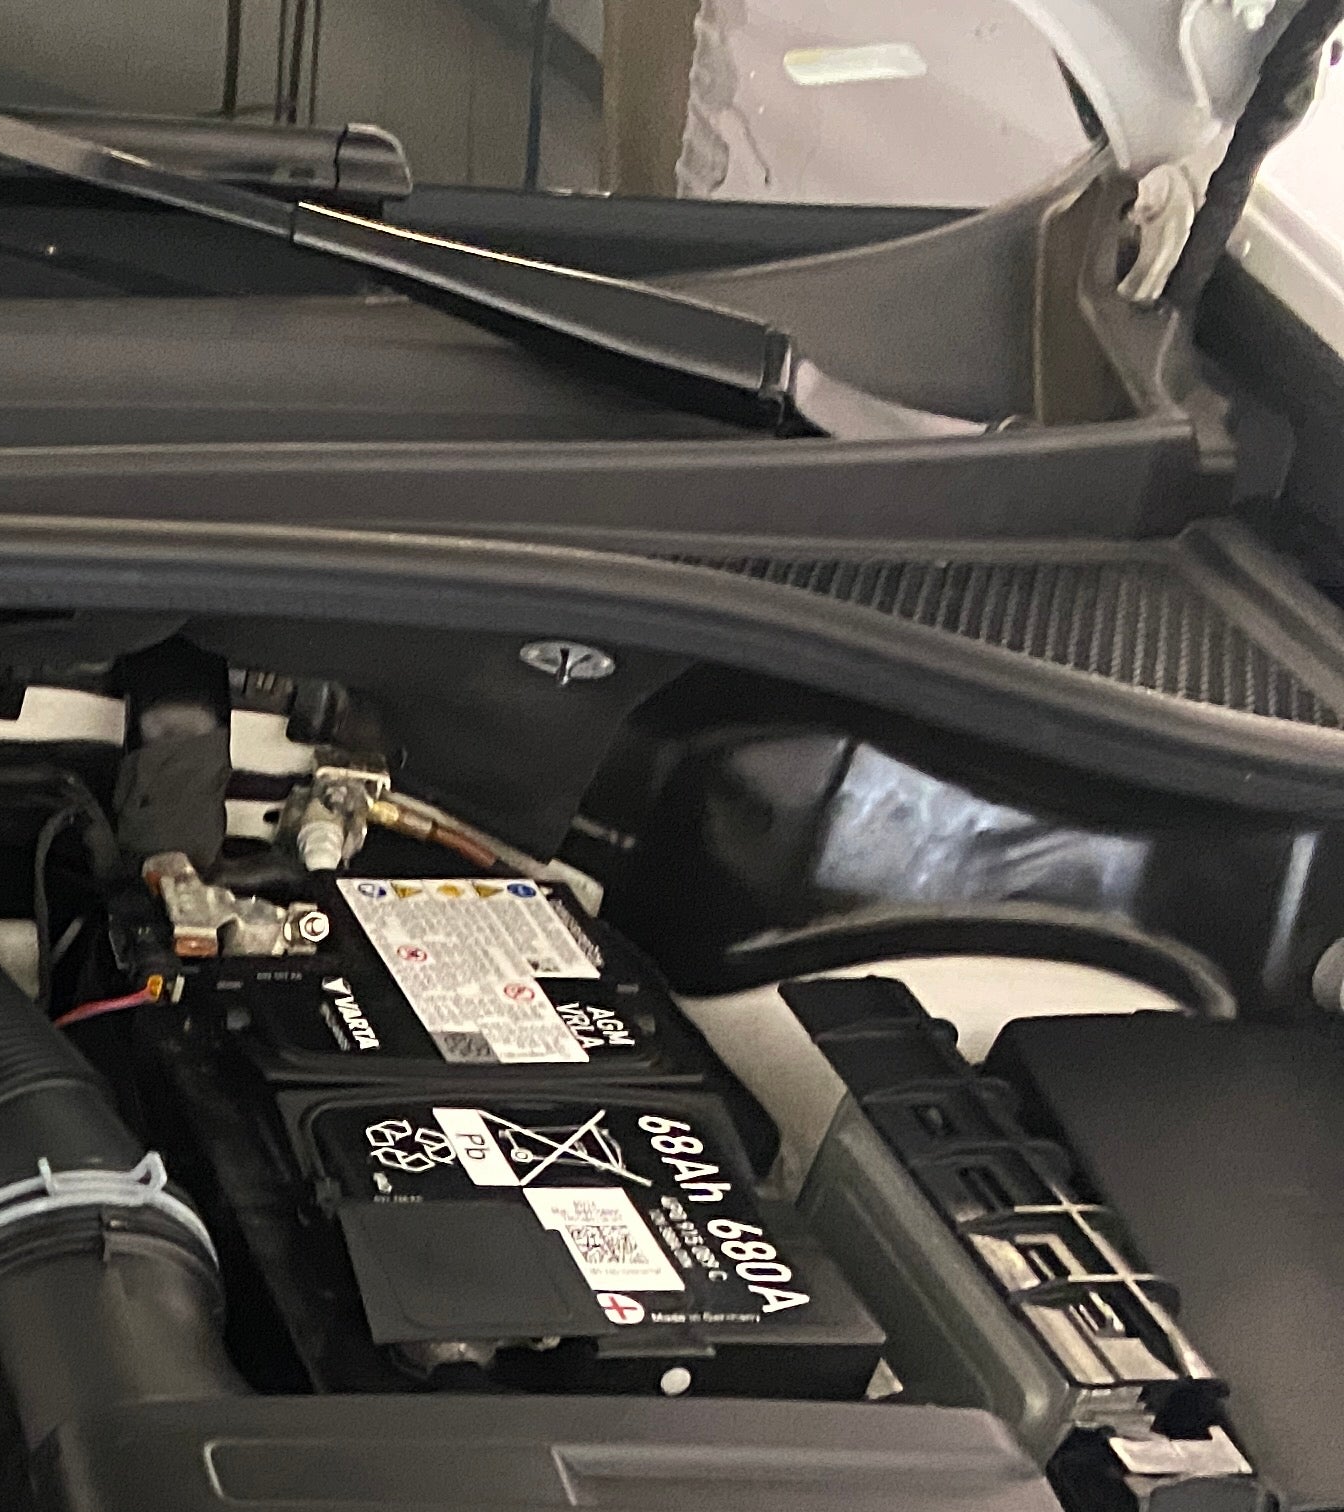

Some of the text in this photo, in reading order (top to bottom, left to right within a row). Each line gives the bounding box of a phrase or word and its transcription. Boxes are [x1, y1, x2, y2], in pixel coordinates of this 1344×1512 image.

[334, 994, 380, 1050] VARTA
[556, 1001, 606, 1049] VRLA
[586, 1005, 636, 1047] AGM
[455, 1132, 490, 1160] Pb
[637, 1114, 732, 1202] 68Ah
[706, 1218, 811, 1313] 680A
